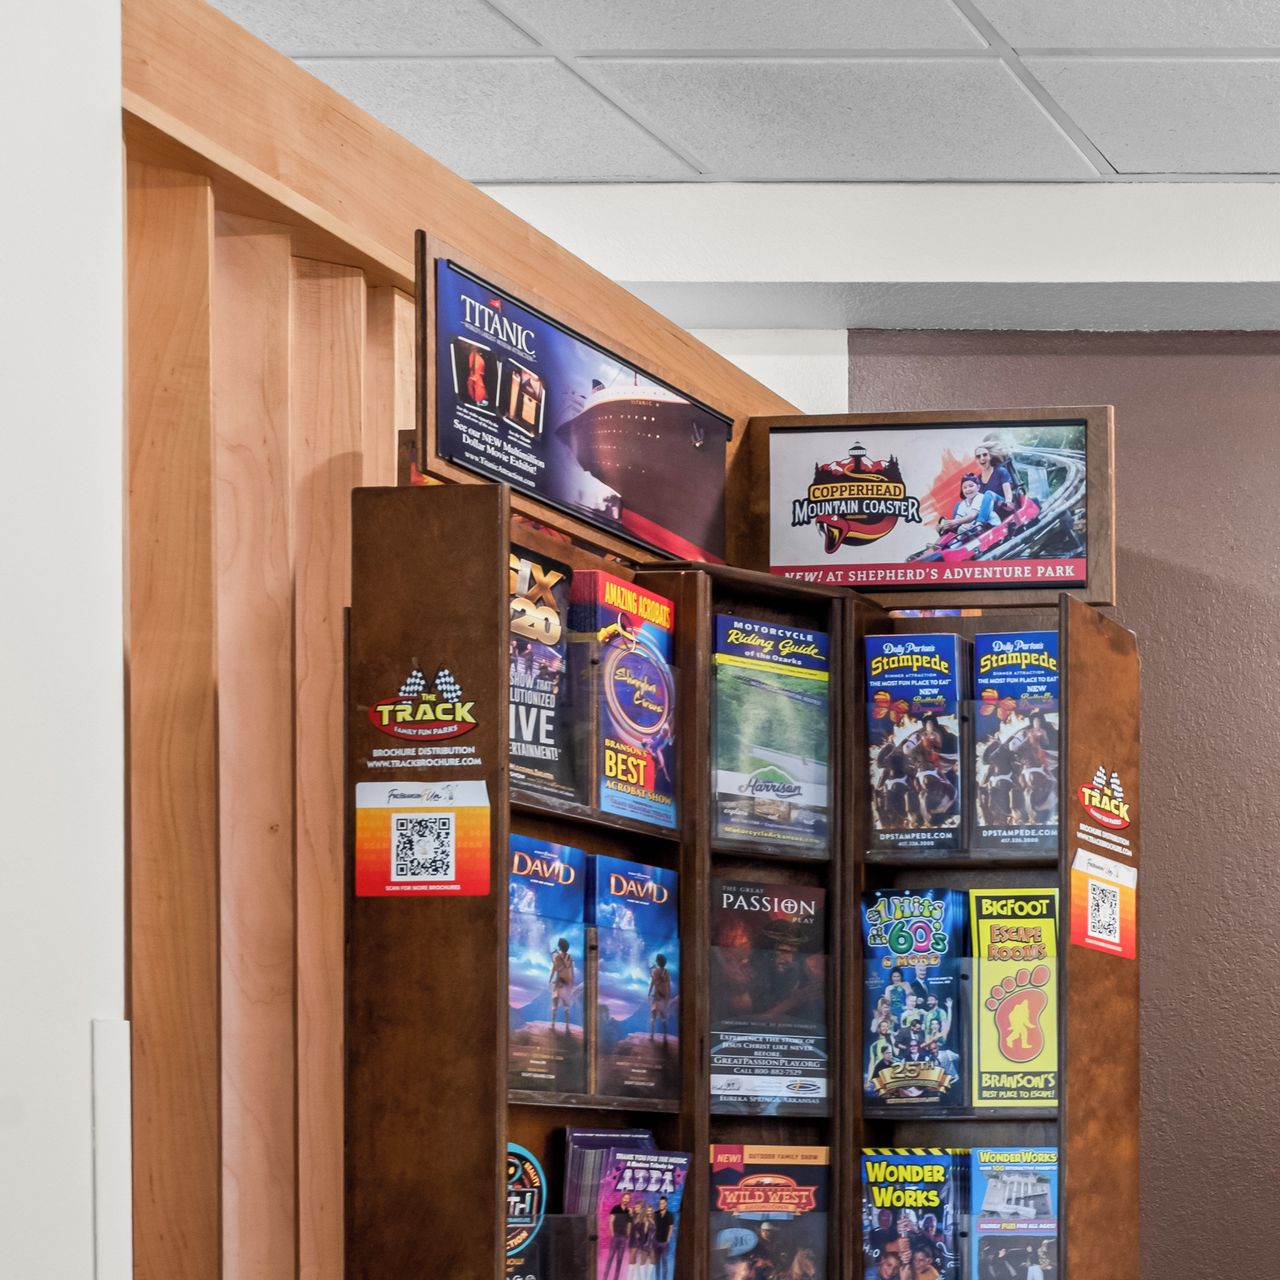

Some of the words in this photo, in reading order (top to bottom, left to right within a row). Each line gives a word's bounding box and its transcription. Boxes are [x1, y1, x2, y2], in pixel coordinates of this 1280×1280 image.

[461, 294, 536, 356] TITANIC
[462, 433, 486, 452] Dollar
[486, 444, 509, 463] Movie
[481, 431, 502, 448] NEW
[812, 484, 902, 499] COPPERHEAD
[794, 500, 860, 524] MOUNTAIN
[863, 499, 921, 522] COASTER
[826, 571, 843, 582] AT
[848, 567, 938, 582] SHEPHERD'S
[943, 566, 1033, 579] ADVENTURE
[1036, 564, 1076, 577] PARK
[605, 582, 637, 613] AMAZING
[637, 596, 671, 629] ACROBATS
[733, 621, 814, 642] MOTORCYCLE
[728, 629, 775, 653] Riding
[778, 639, 826, 660] Guide
[756, 651, 771, 659] the
[772, 655, 802, 665] Ozarks
[871, 654, 949, 676] Stampede
[980, 652, 1057, 673] Stampede
[421, 693, 437, 701] THE
[376, 701, 477, 726] TRACK
[509, 703, 555, 744] IVE
[418, 727, 432, 736] FUN
[372, 747, 416, 757] BROCHURE
[418, 746, 476, 756] DISTRIBUTION
[605, 749, 647, 786] BEST
[1082, 788, 1130, 822] TRACK
[512, 851, 576, 886] DAVID
[609, 872, 669, 905] DAVID
[739, 886, 764, 894] GREAT
[722, 893, 816, 916] PASSION
[890, 896, 945, 920] Hits
[981, 899, 1050, 916] BIGFOOT
[888, 920, 949, 954] 60's
[990, 924, 1042, 943] ESCAPE
[987, 943, 1048, 962] ROOMS
[890, 1062, 936, 1079] 25TH
[982, 1072, 1056, 1089] BRANSON'S
[982, 1090, 998, 1098] BEST
[998, 1090, 1018, 1098] PLACE
[1019, 1090, 1030, 1098] TO
[1030, 1089, 1055, 1098] ESCAPE!
[716, 1153, 742, 1163] NEW!
[866, 1161, 945, 1183] WONDER
[724, 1191, 765, 1203] WILD
[768, 1191, 810, 1203] WEST
[872, 1186, 941, 1208] WORKS
